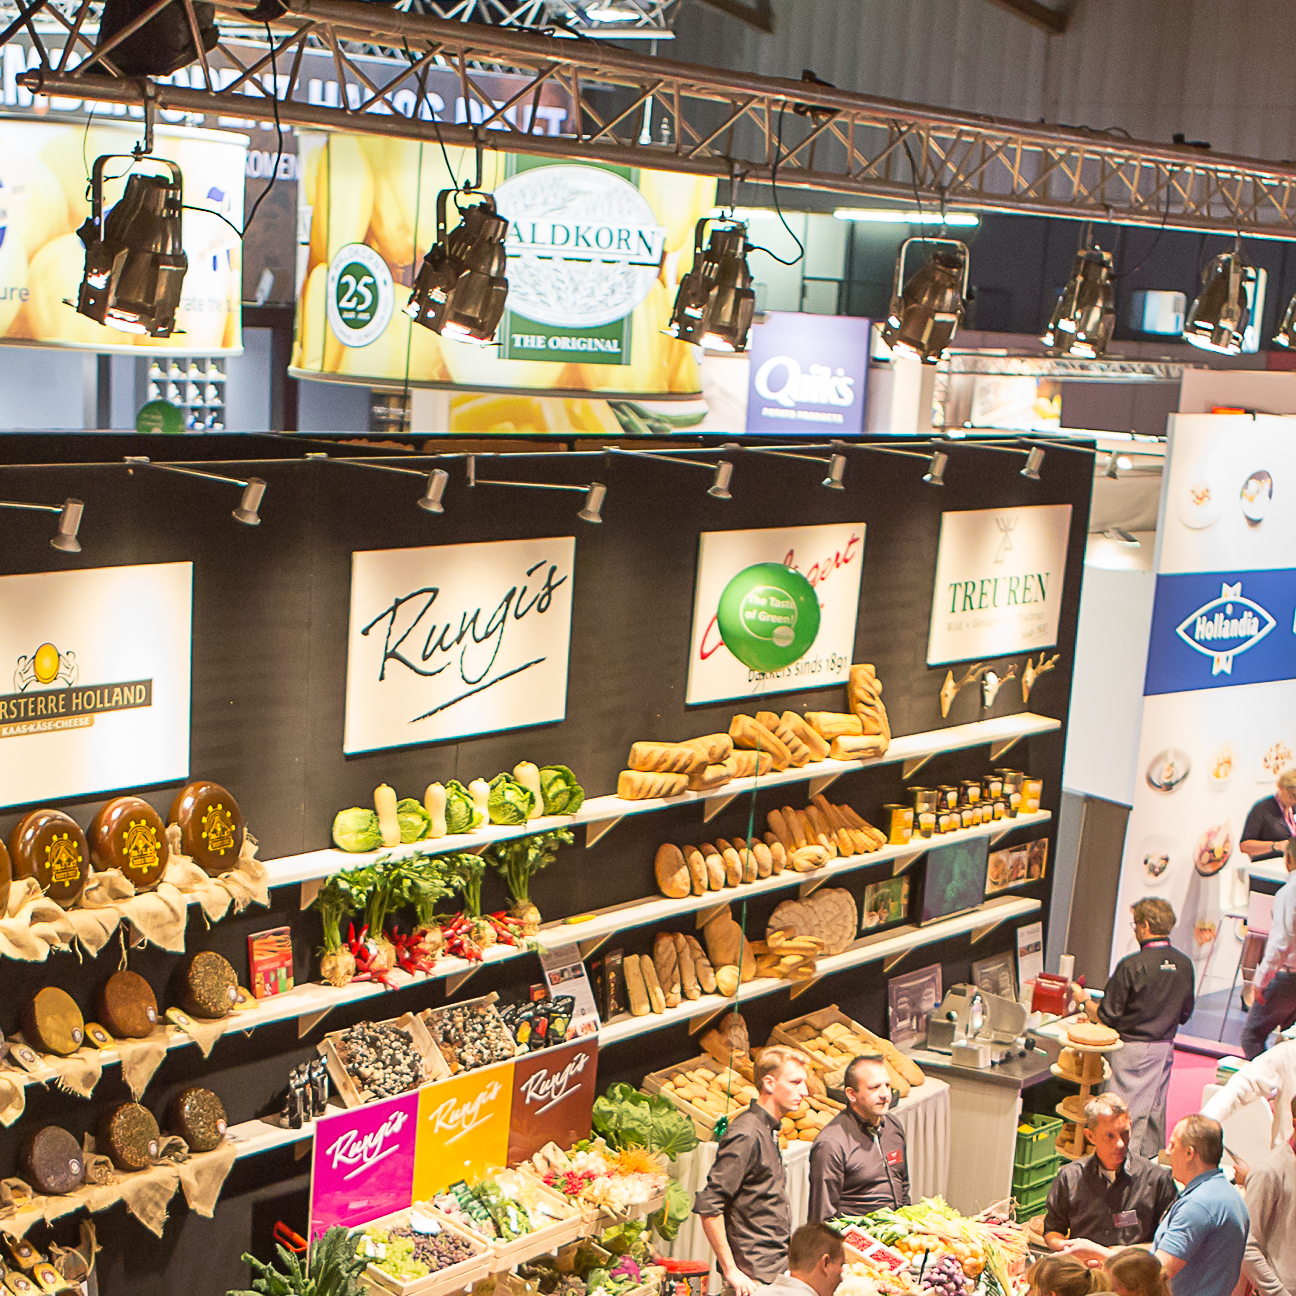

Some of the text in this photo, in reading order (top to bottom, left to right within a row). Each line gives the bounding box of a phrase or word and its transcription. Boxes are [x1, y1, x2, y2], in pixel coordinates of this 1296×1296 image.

[508, 221, 655, 257] ALDKORN
[339, 274, 374, 311] 25
[512, 334, 622, 354] THE ORIGINAL
[769, 597, 796, 608] Taste
[948, 572, 1050, 614] TREUREN
[361, 560, 568, 684] Rungis
[745, 610, 794, 624] of Green!
[1194, 611, 1259, 641] Hollandia
[795, 655, 822, 677] sinds
[826, 653, 848, 675] 1891
[72, 684, 146, 711] HOLLAND
[520, 1052, 590, 1105] Rungis
[429, 1081, 503, 1134] Rungis
[326, 1110, 408, 1170] Rungis
